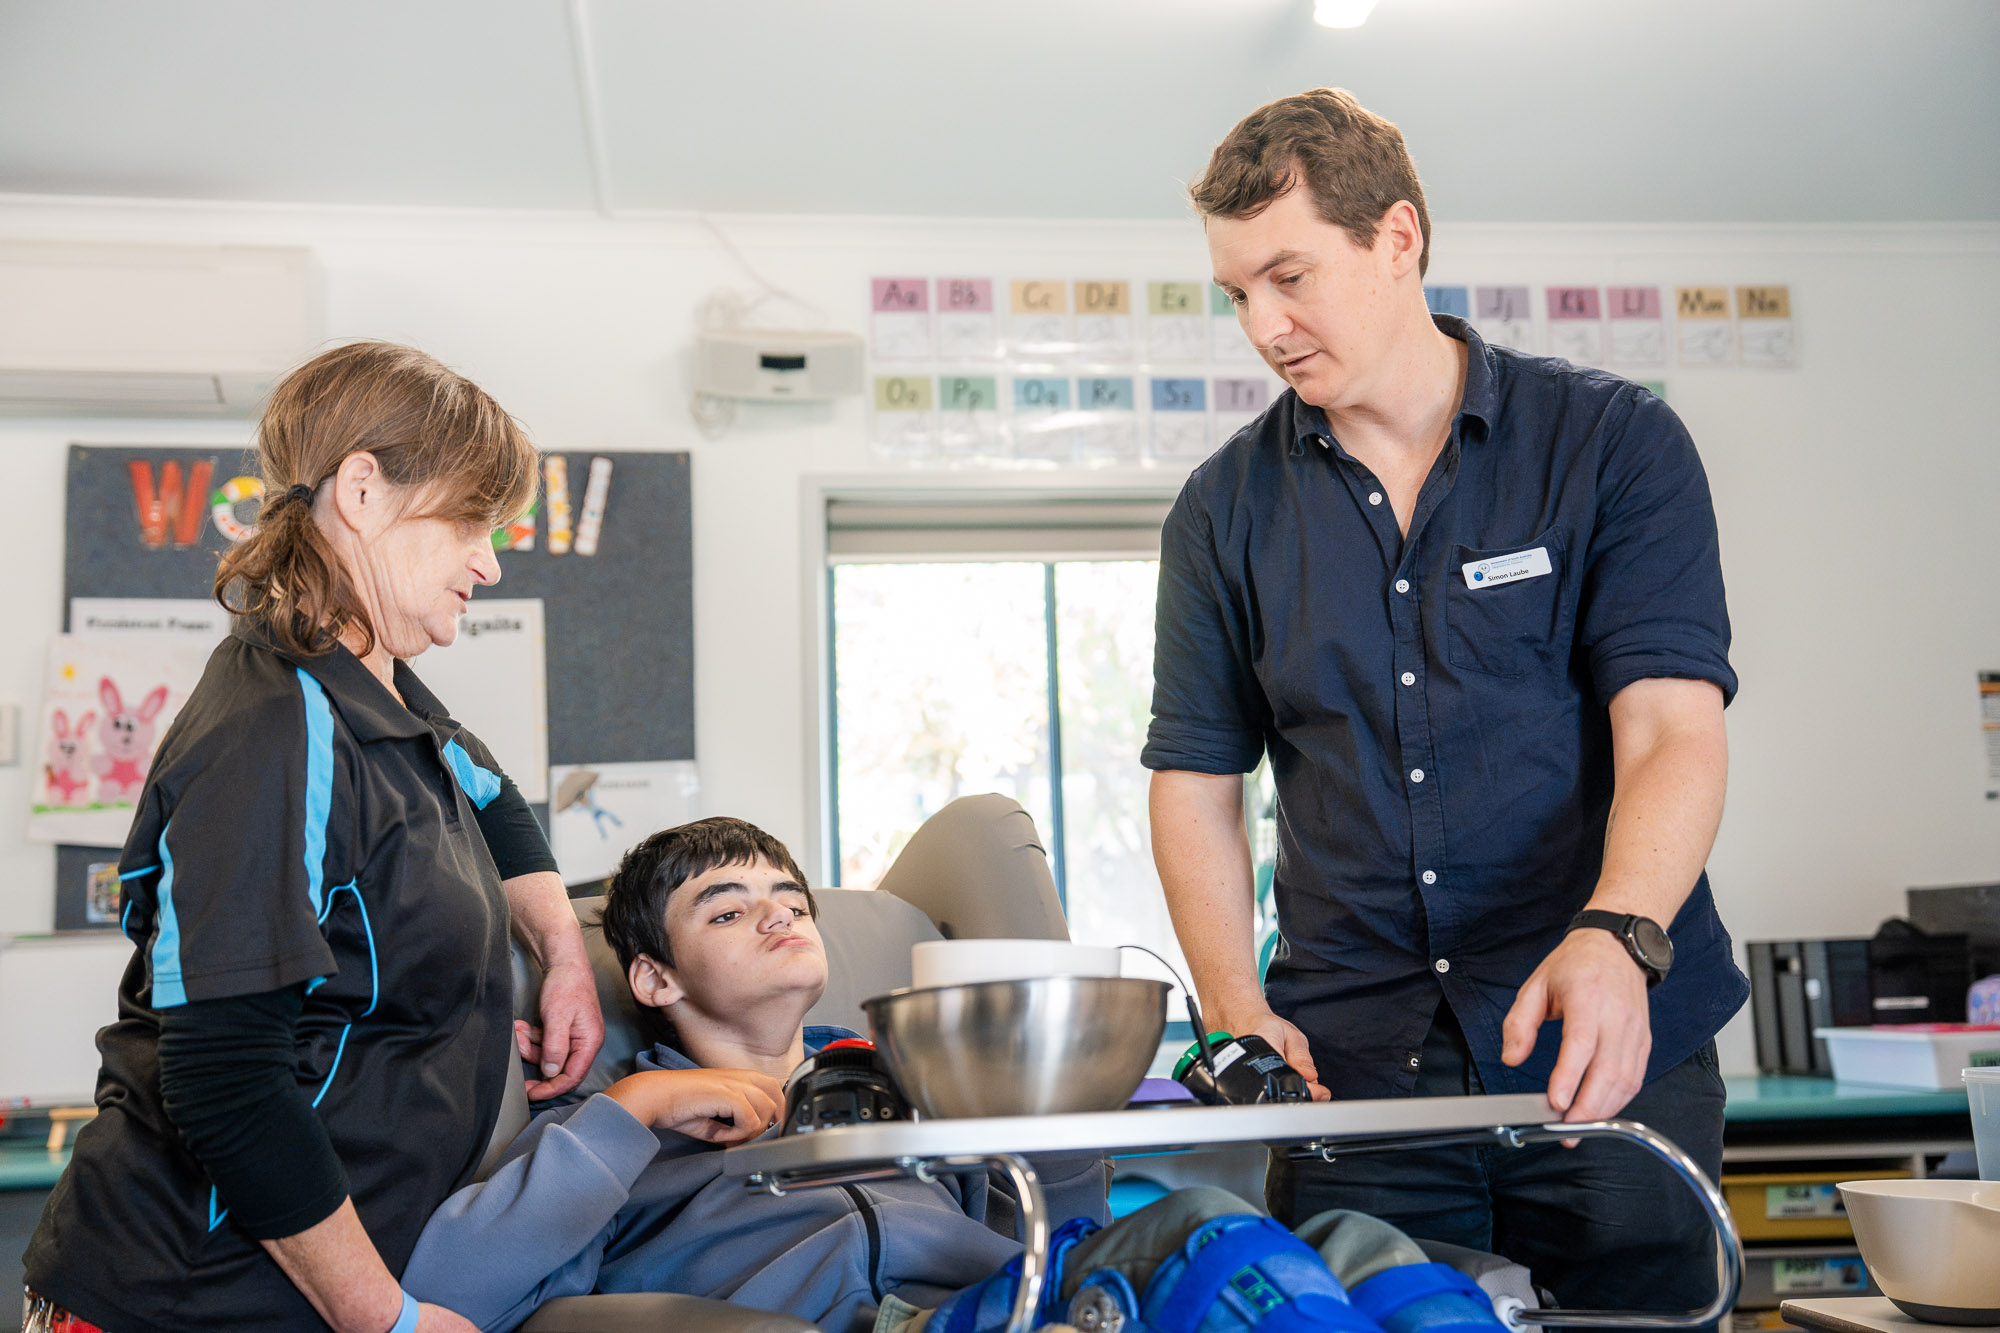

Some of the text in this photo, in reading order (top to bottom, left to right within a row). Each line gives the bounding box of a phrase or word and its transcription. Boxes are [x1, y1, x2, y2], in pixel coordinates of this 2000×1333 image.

[881, 279, 918, 306] Aa
[1022, 280, 1052, 310] Cc
[1086, 281, 1120, 310] Dd
[1161, 282, 1190, 310] Ee
[1488, 569, 1529, 582] Simon Laube
